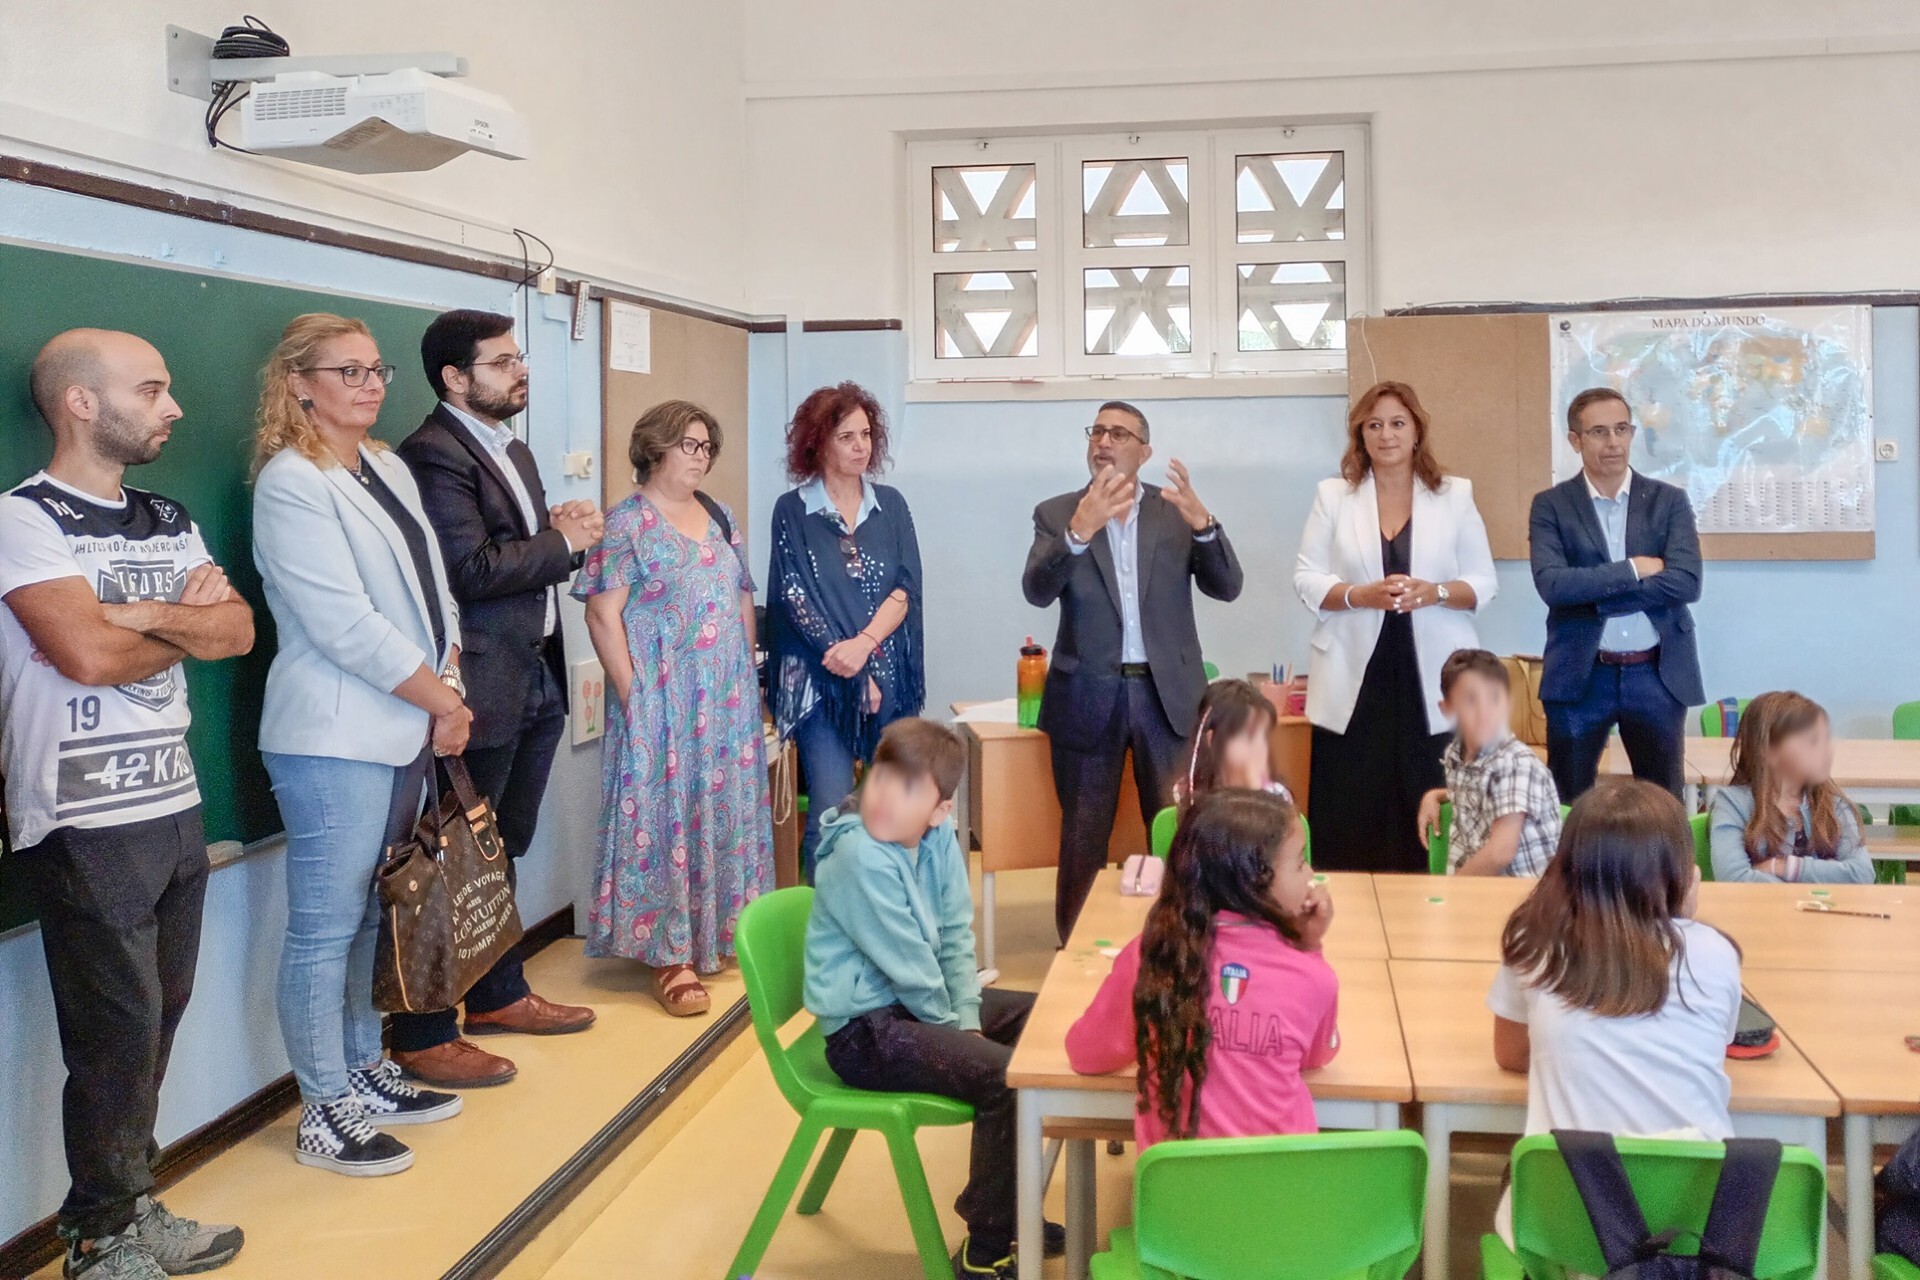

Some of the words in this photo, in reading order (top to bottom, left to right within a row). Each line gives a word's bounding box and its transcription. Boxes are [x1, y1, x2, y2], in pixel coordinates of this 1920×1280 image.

[1652, 318, 1689, 329] MAPA
[1692, 317, 1711, 327] DO
[1714, 315, 1766, 327] MUNDO
[66, 695, 101, 733] 19
[474, 871, 505, 888] VOYAGE
[470, 884, 511, 923] VUITTON
[1223, 966, 1248, 979] ITALIA
[1211, 1007, 1283, 1057] ALIA
